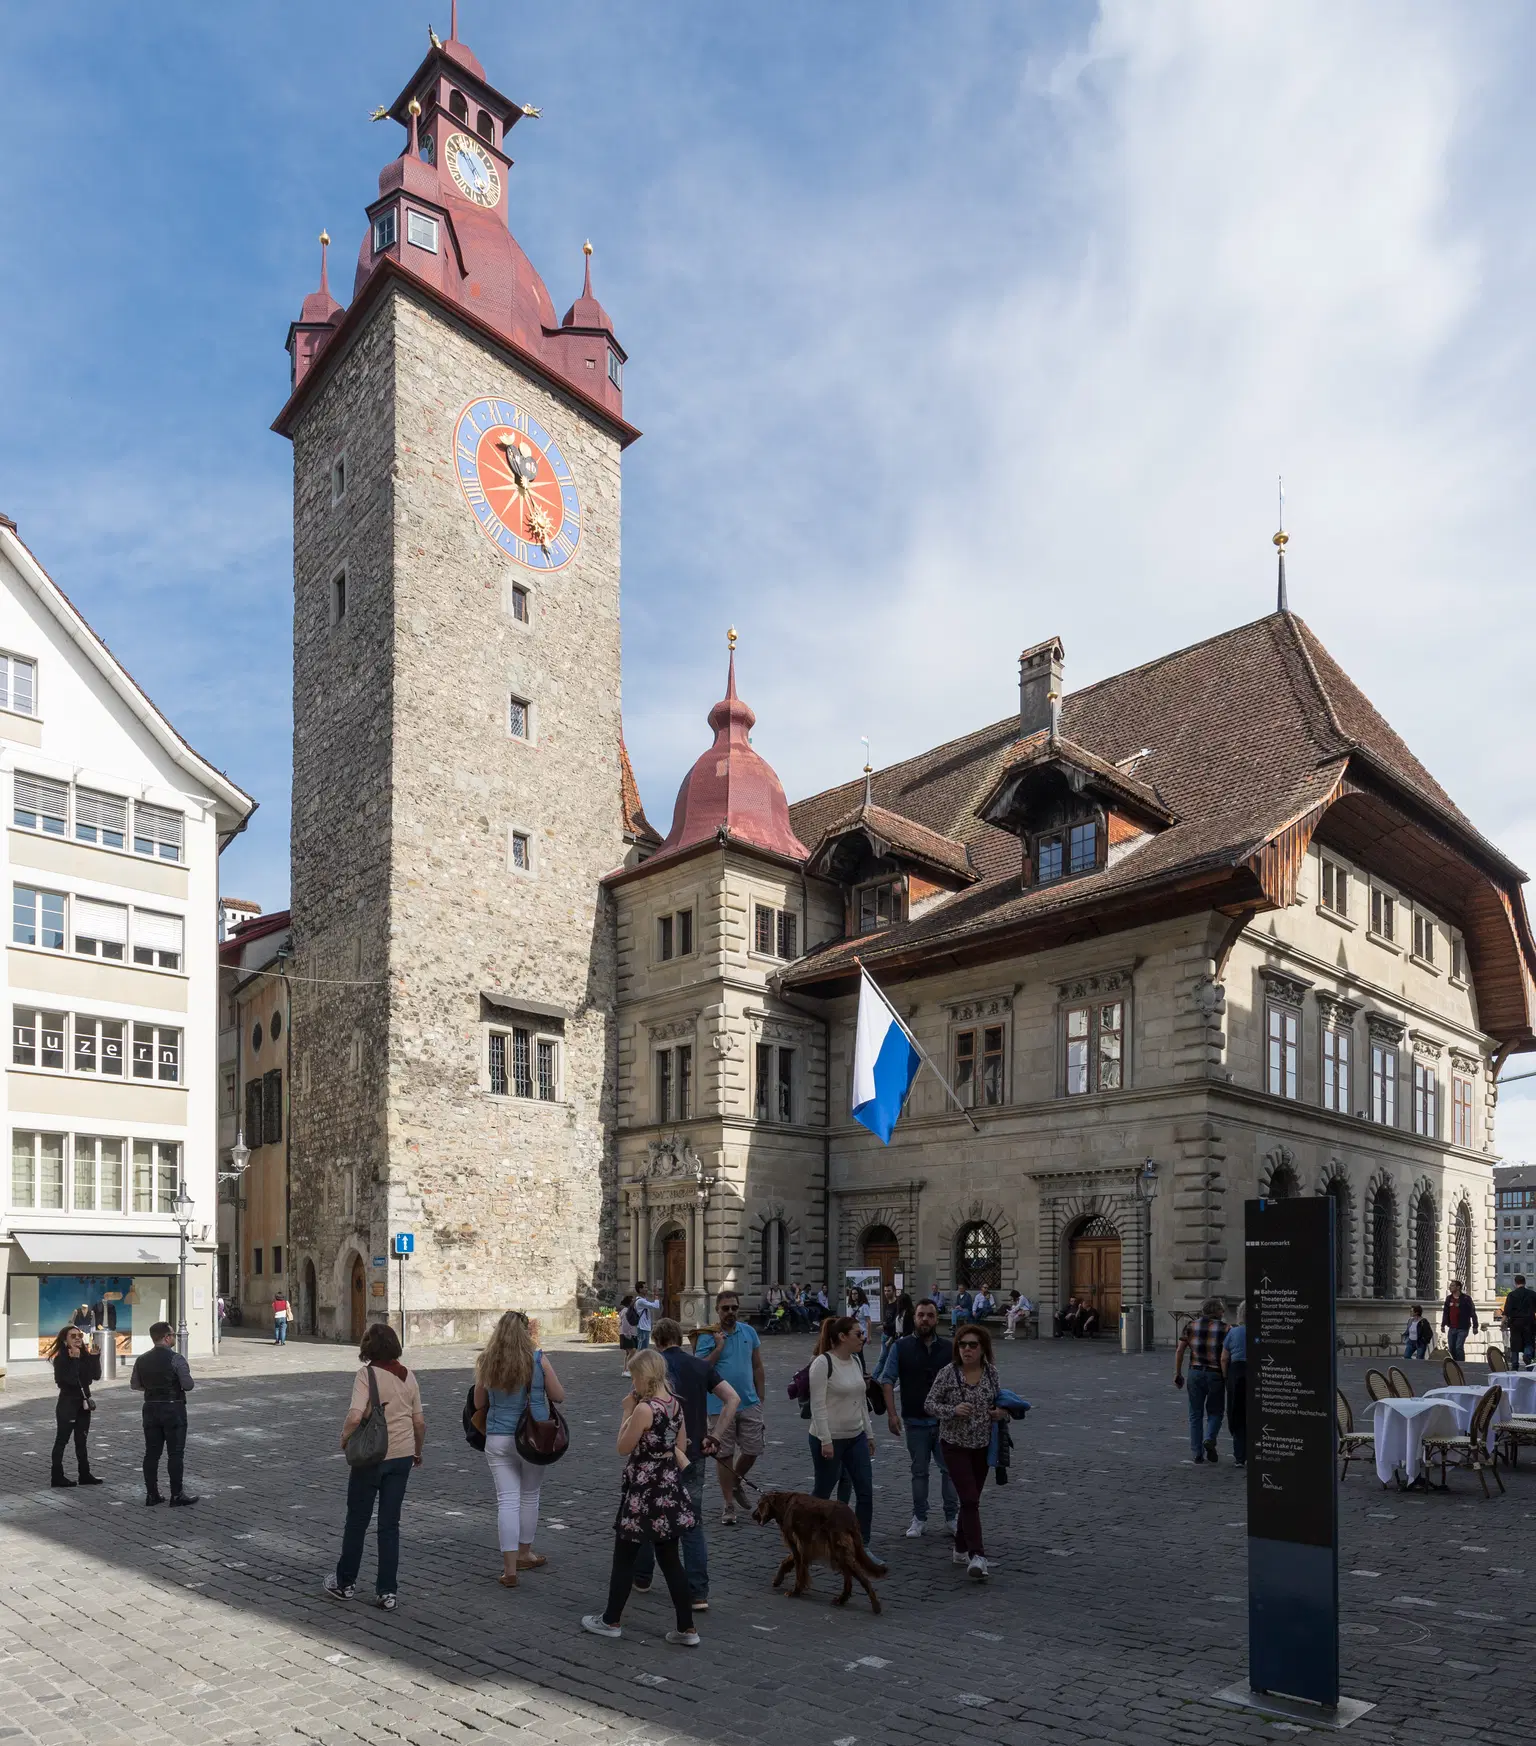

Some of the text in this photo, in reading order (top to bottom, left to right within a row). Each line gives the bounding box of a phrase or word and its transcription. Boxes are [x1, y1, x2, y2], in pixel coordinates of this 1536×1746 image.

[514, 408, 529, 434] XII
[557, 476, 574, 486] II
[484, 513, 504, 541] VII
[564, 508, 580, 528] III
[516, 538, 528, 564] VI
[18, 1028, 173, 1063] Luzern
[1262, 1435, 1304, 1443] Schwanenplatz
